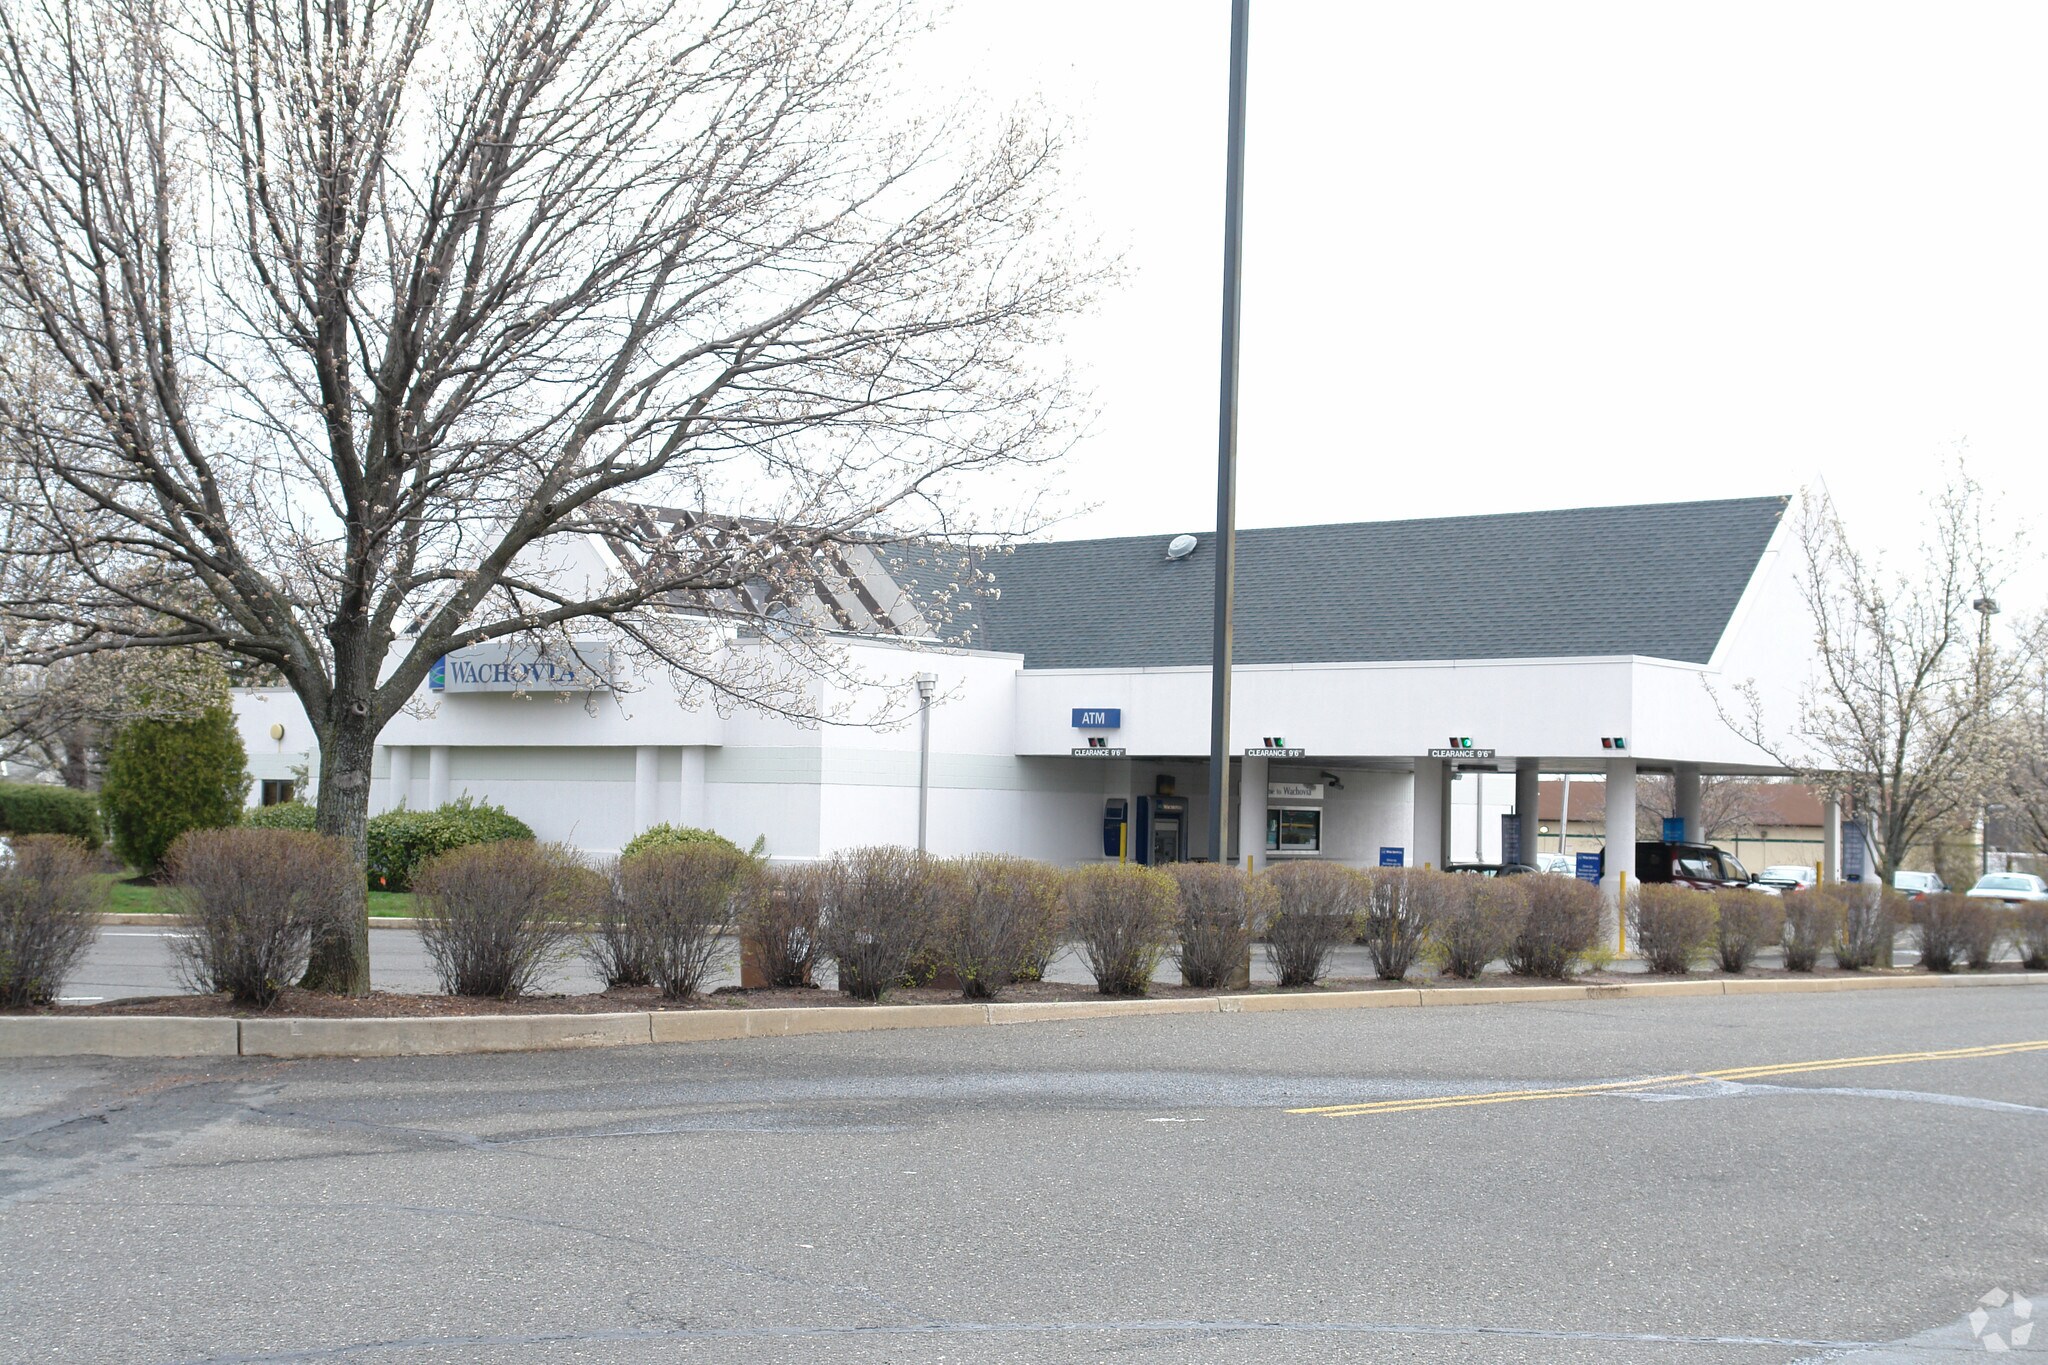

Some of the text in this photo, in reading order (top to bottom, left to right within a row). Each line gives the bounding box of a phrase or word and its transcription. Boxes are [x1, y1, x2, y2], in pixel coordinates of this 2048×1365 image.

[450, 660, 579, 684] WACHOVIA
[1081, 711, 1105, 725] ATM
[1248, 749, 1286, 757] CLEARANCE
[1431, 750, 1474, 758] CLEARANCE
